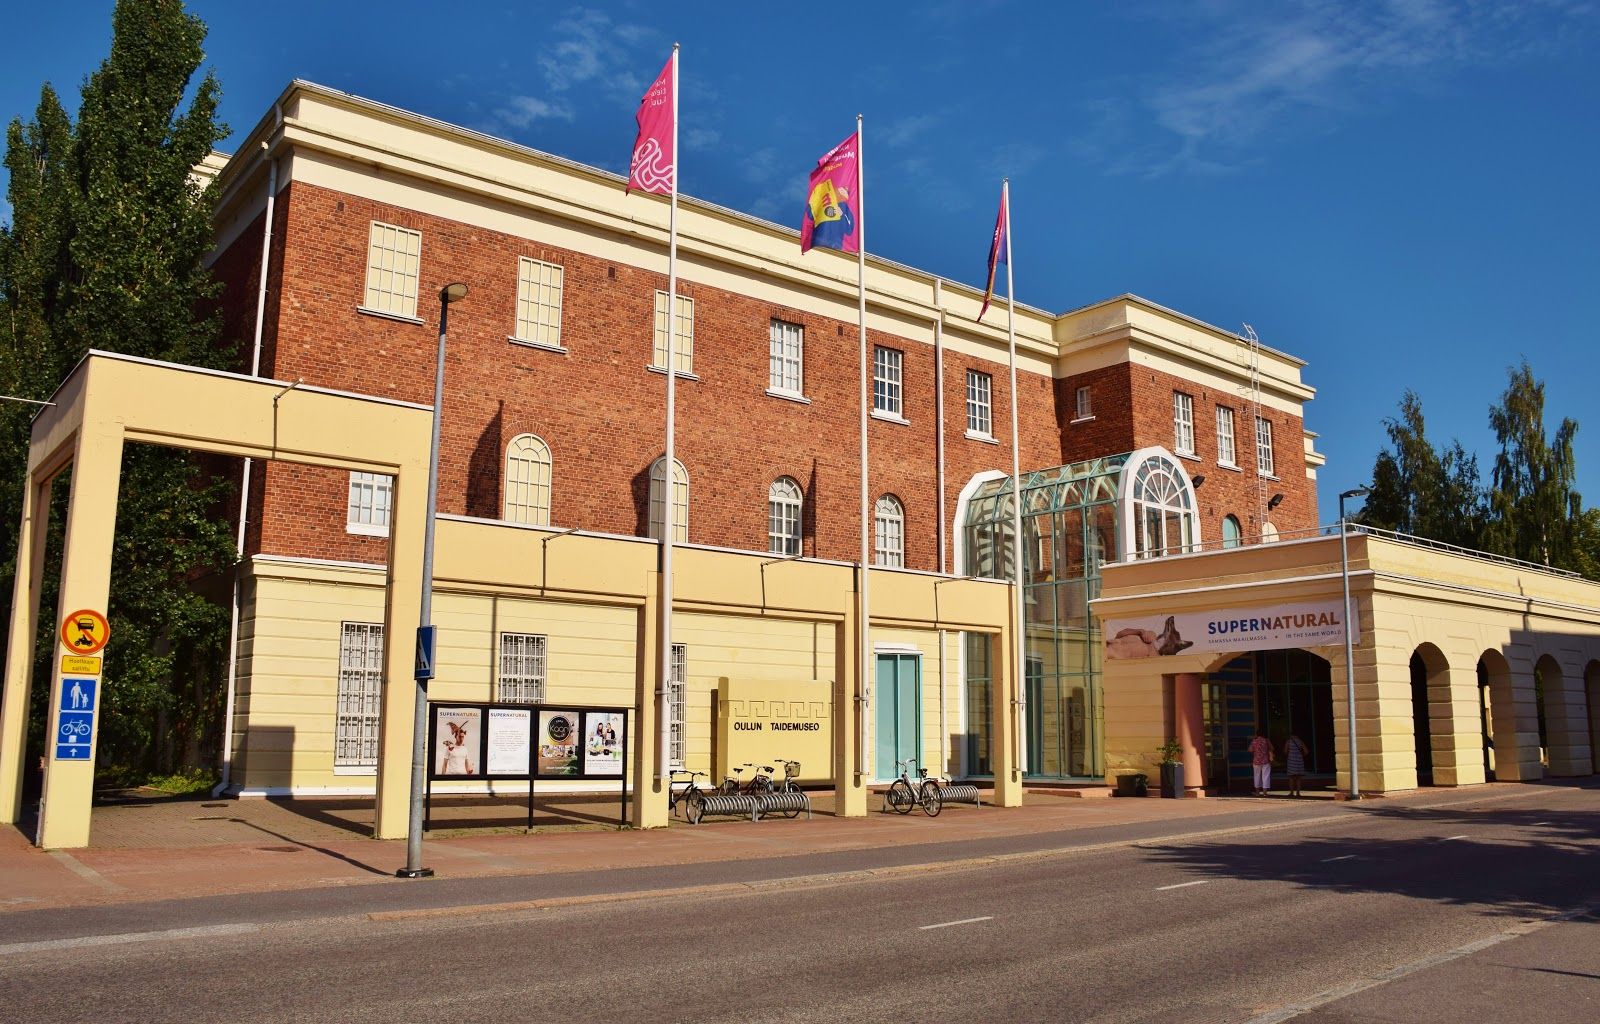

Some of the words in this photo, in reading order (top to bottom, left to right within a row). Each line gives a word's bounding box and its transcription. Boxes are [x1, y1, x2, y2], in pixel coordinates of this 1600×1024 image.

[1208, 612, 1340, 635] SUPERNATURAL
[1321, 629, 1342, 637] WORLD
[734, 721, 762, 731] OULUN
[770, 722, 820, 731] TAIDEMUSEO
